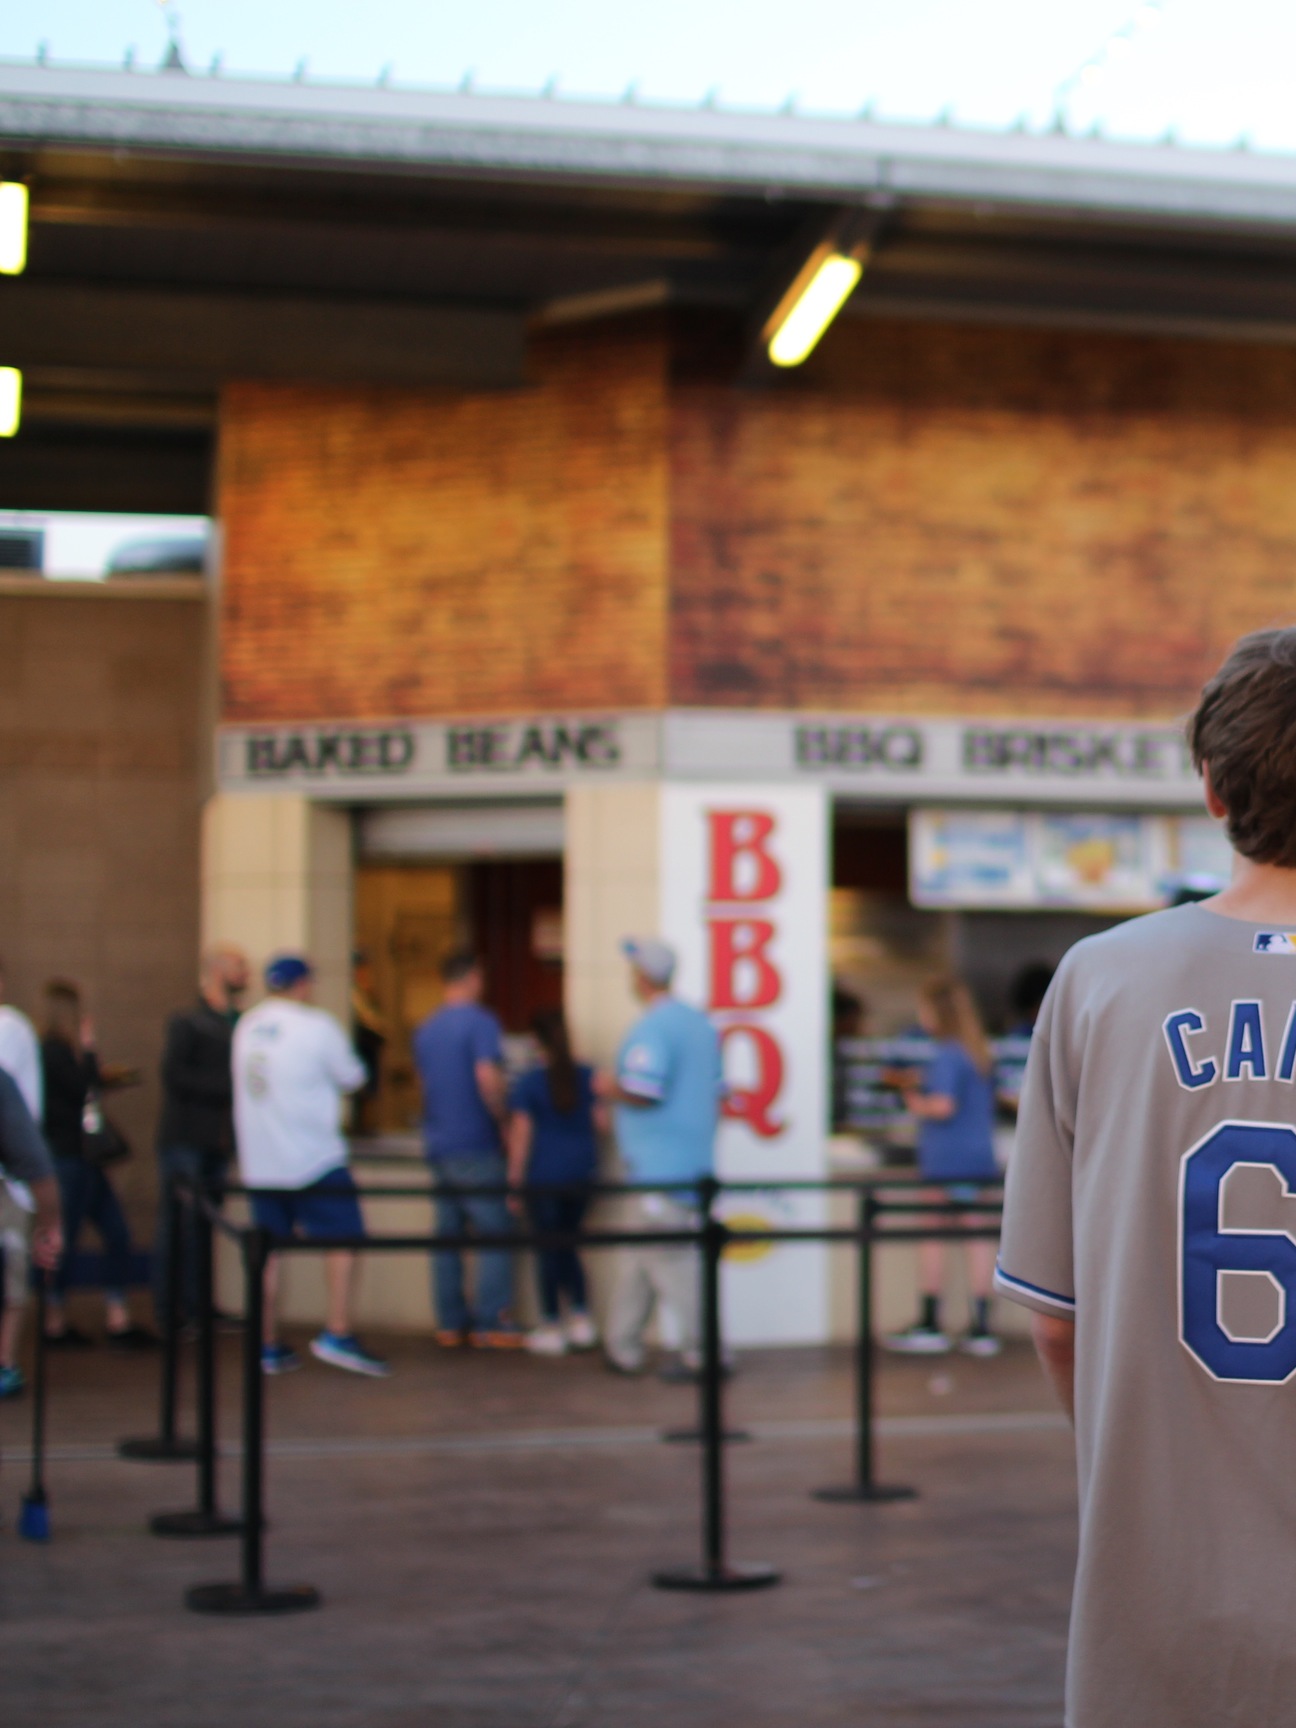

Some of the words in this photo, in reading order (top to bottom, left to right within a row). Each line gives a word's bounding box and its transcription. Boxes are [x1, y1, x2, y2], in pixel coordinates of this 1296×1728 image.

[246, 729, 413, 776] BAKED
[446, 724, 620, 770] BEANS
[794, 726, 921, 772] BBQ
[704, 807, 786, 1139] BBQ
